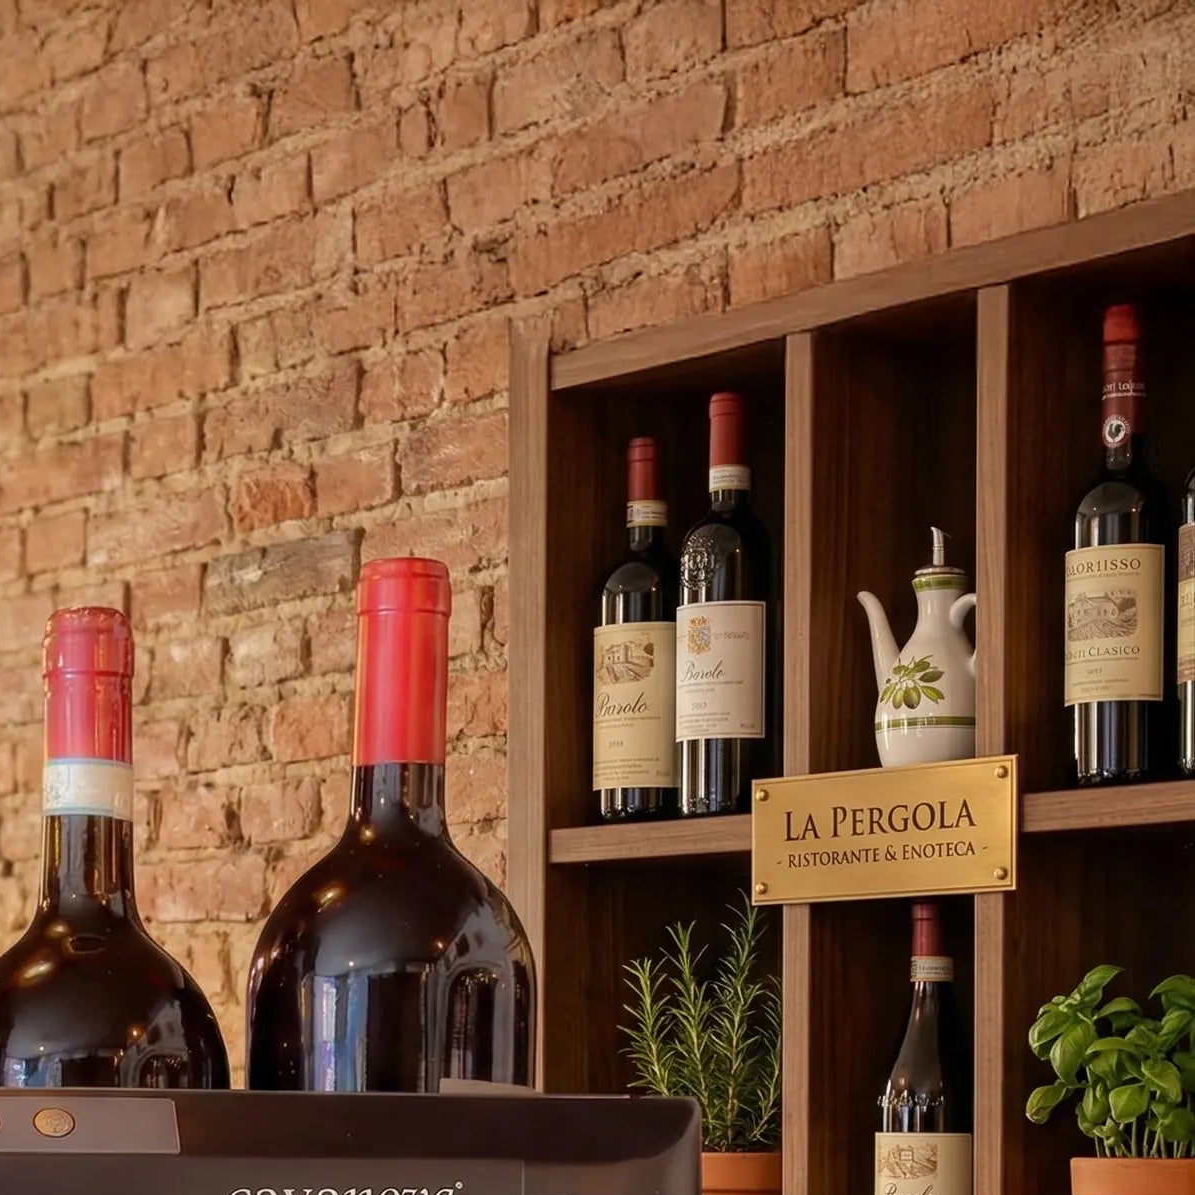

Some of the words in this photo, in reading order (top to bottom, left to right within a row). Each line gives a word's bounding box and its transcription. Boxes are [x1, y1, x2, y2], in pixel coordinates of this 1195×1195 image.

[1088, 646, 1140, 658] CLASICO
[784, 811, 821, 842] LA
[831, 799, 977, 838] PERGOLA
[788, 848, 880, 868] RISTORANTE
[884, 845, 898, 861] &
[902, 841, 976, 860] ENOTECA
